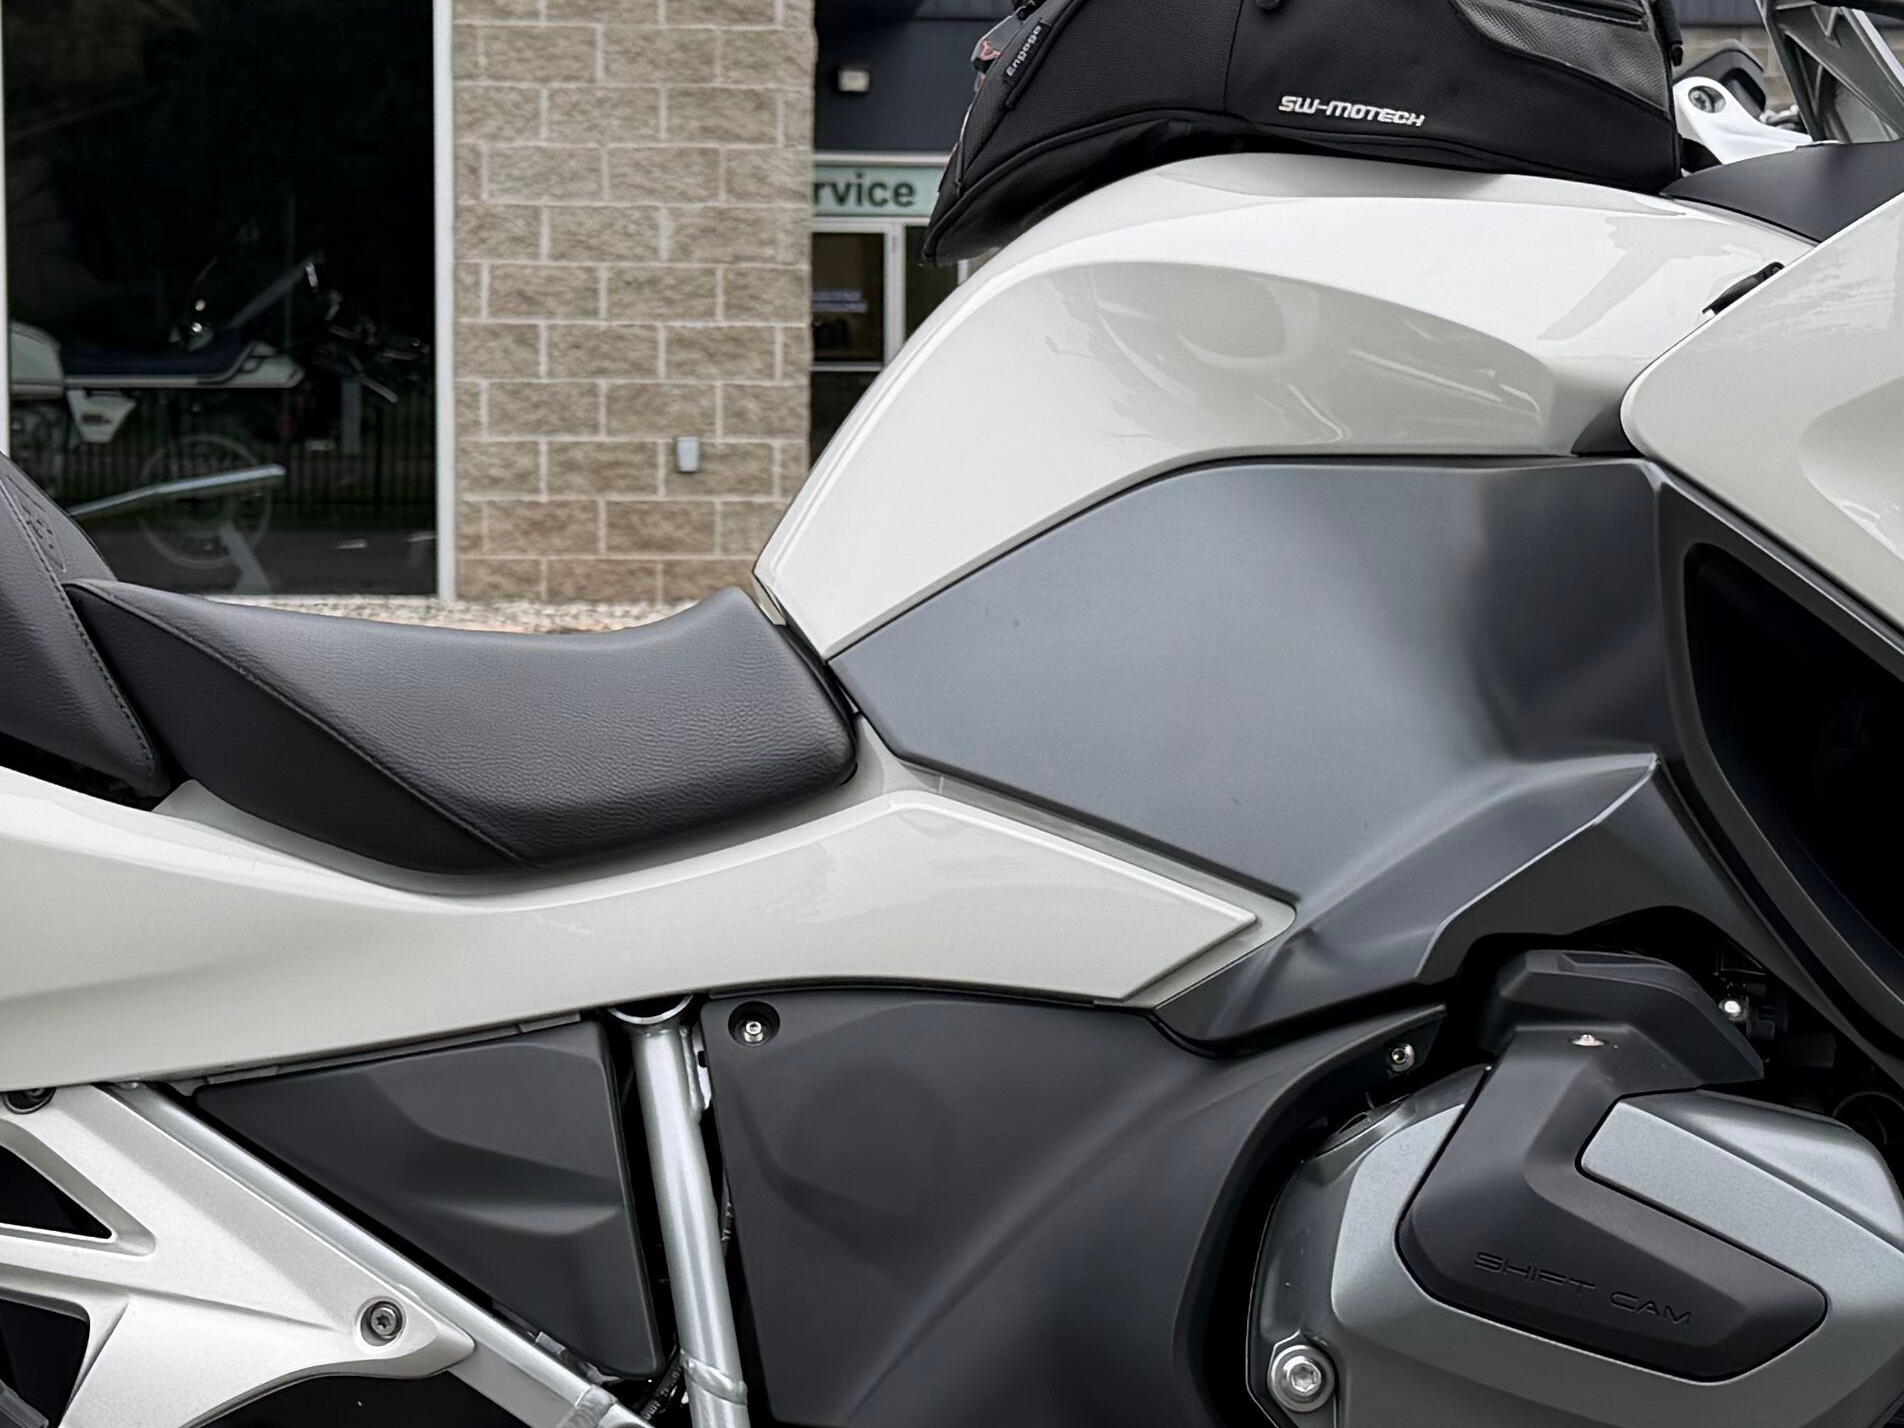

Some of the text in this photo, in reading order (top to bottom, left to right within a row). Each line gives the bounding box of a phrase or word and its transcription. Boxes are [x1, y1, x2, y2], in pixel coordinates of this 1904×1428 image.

[1279, 95, 1426, 126] SW-MOTECH
[813, 173, 915, 208] rvice
[1475, 1251, 1692, 1324] SHIFT CAM
